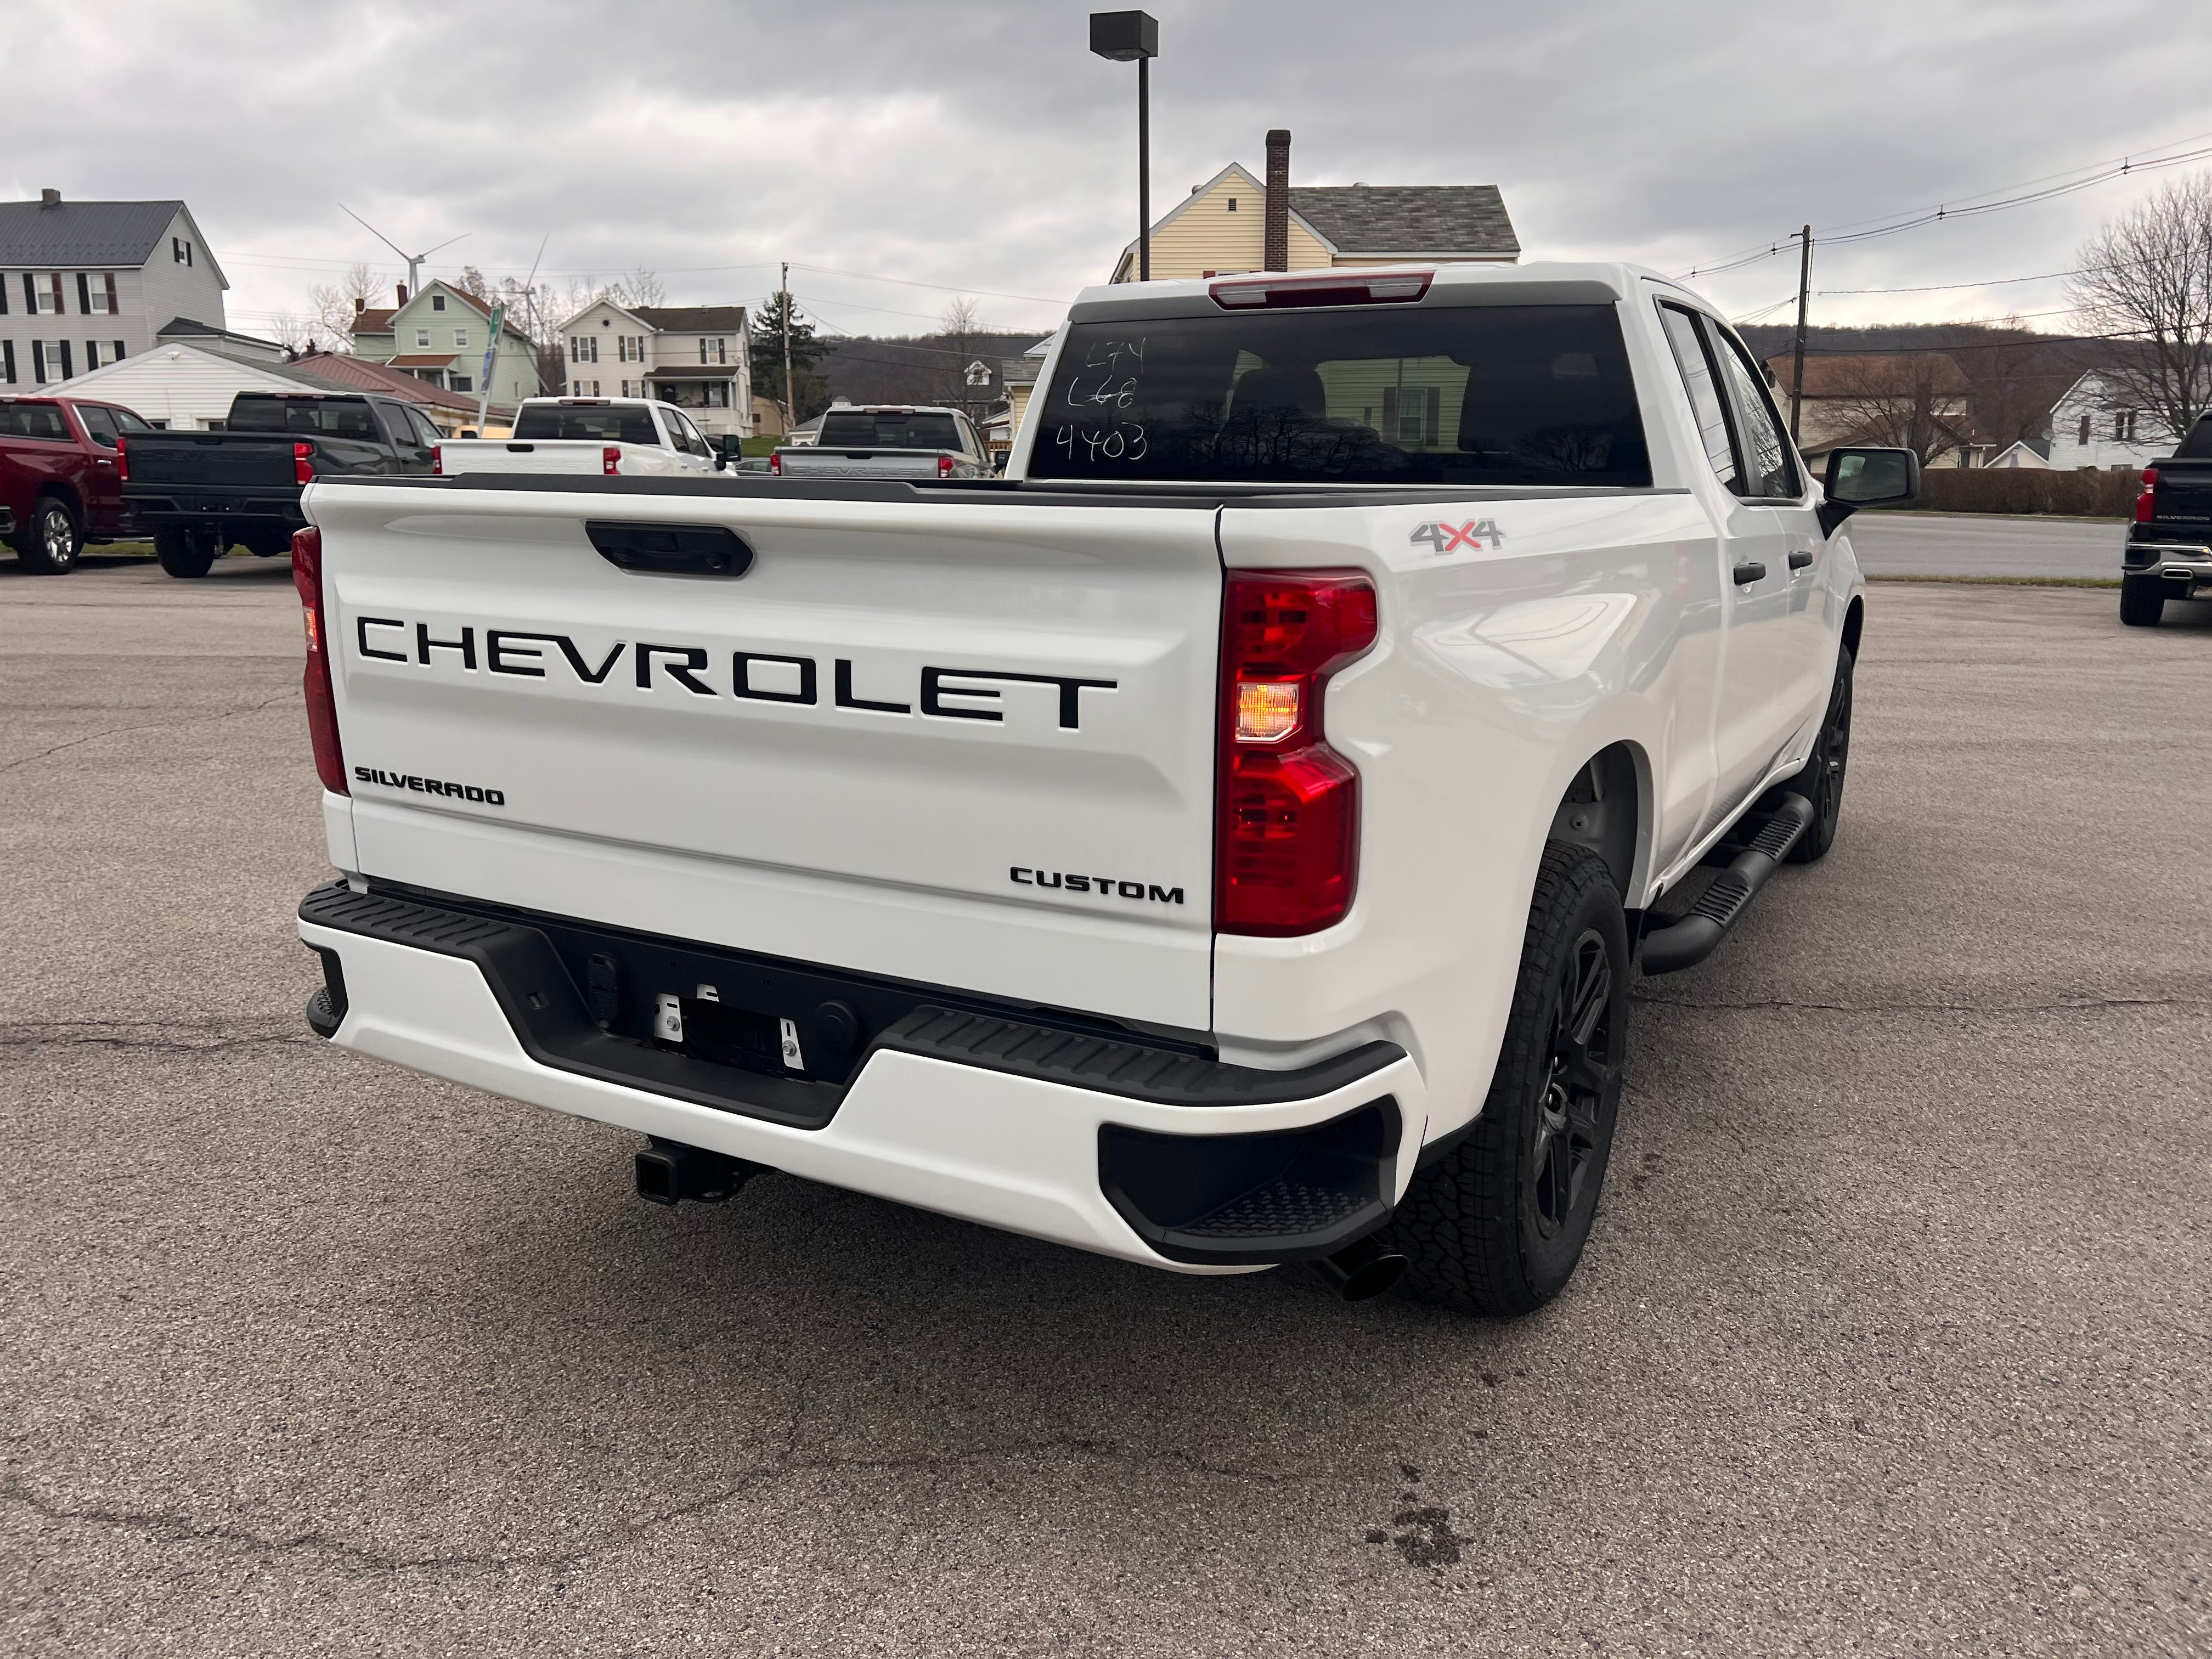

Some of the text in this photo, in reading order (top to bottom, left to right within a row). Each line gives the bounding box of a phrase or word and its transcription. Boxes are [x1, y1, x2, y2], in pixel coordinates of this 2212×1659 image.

[1057, 421, 1148, 461] 4403
[792, 466, 929, 477] CHEVROLET
[357, 616, 1118, 729] CHEVROLET
[354, 766, 505, 805] SILVERADO
[1010, 866, 1183, 904] CUSTOM
